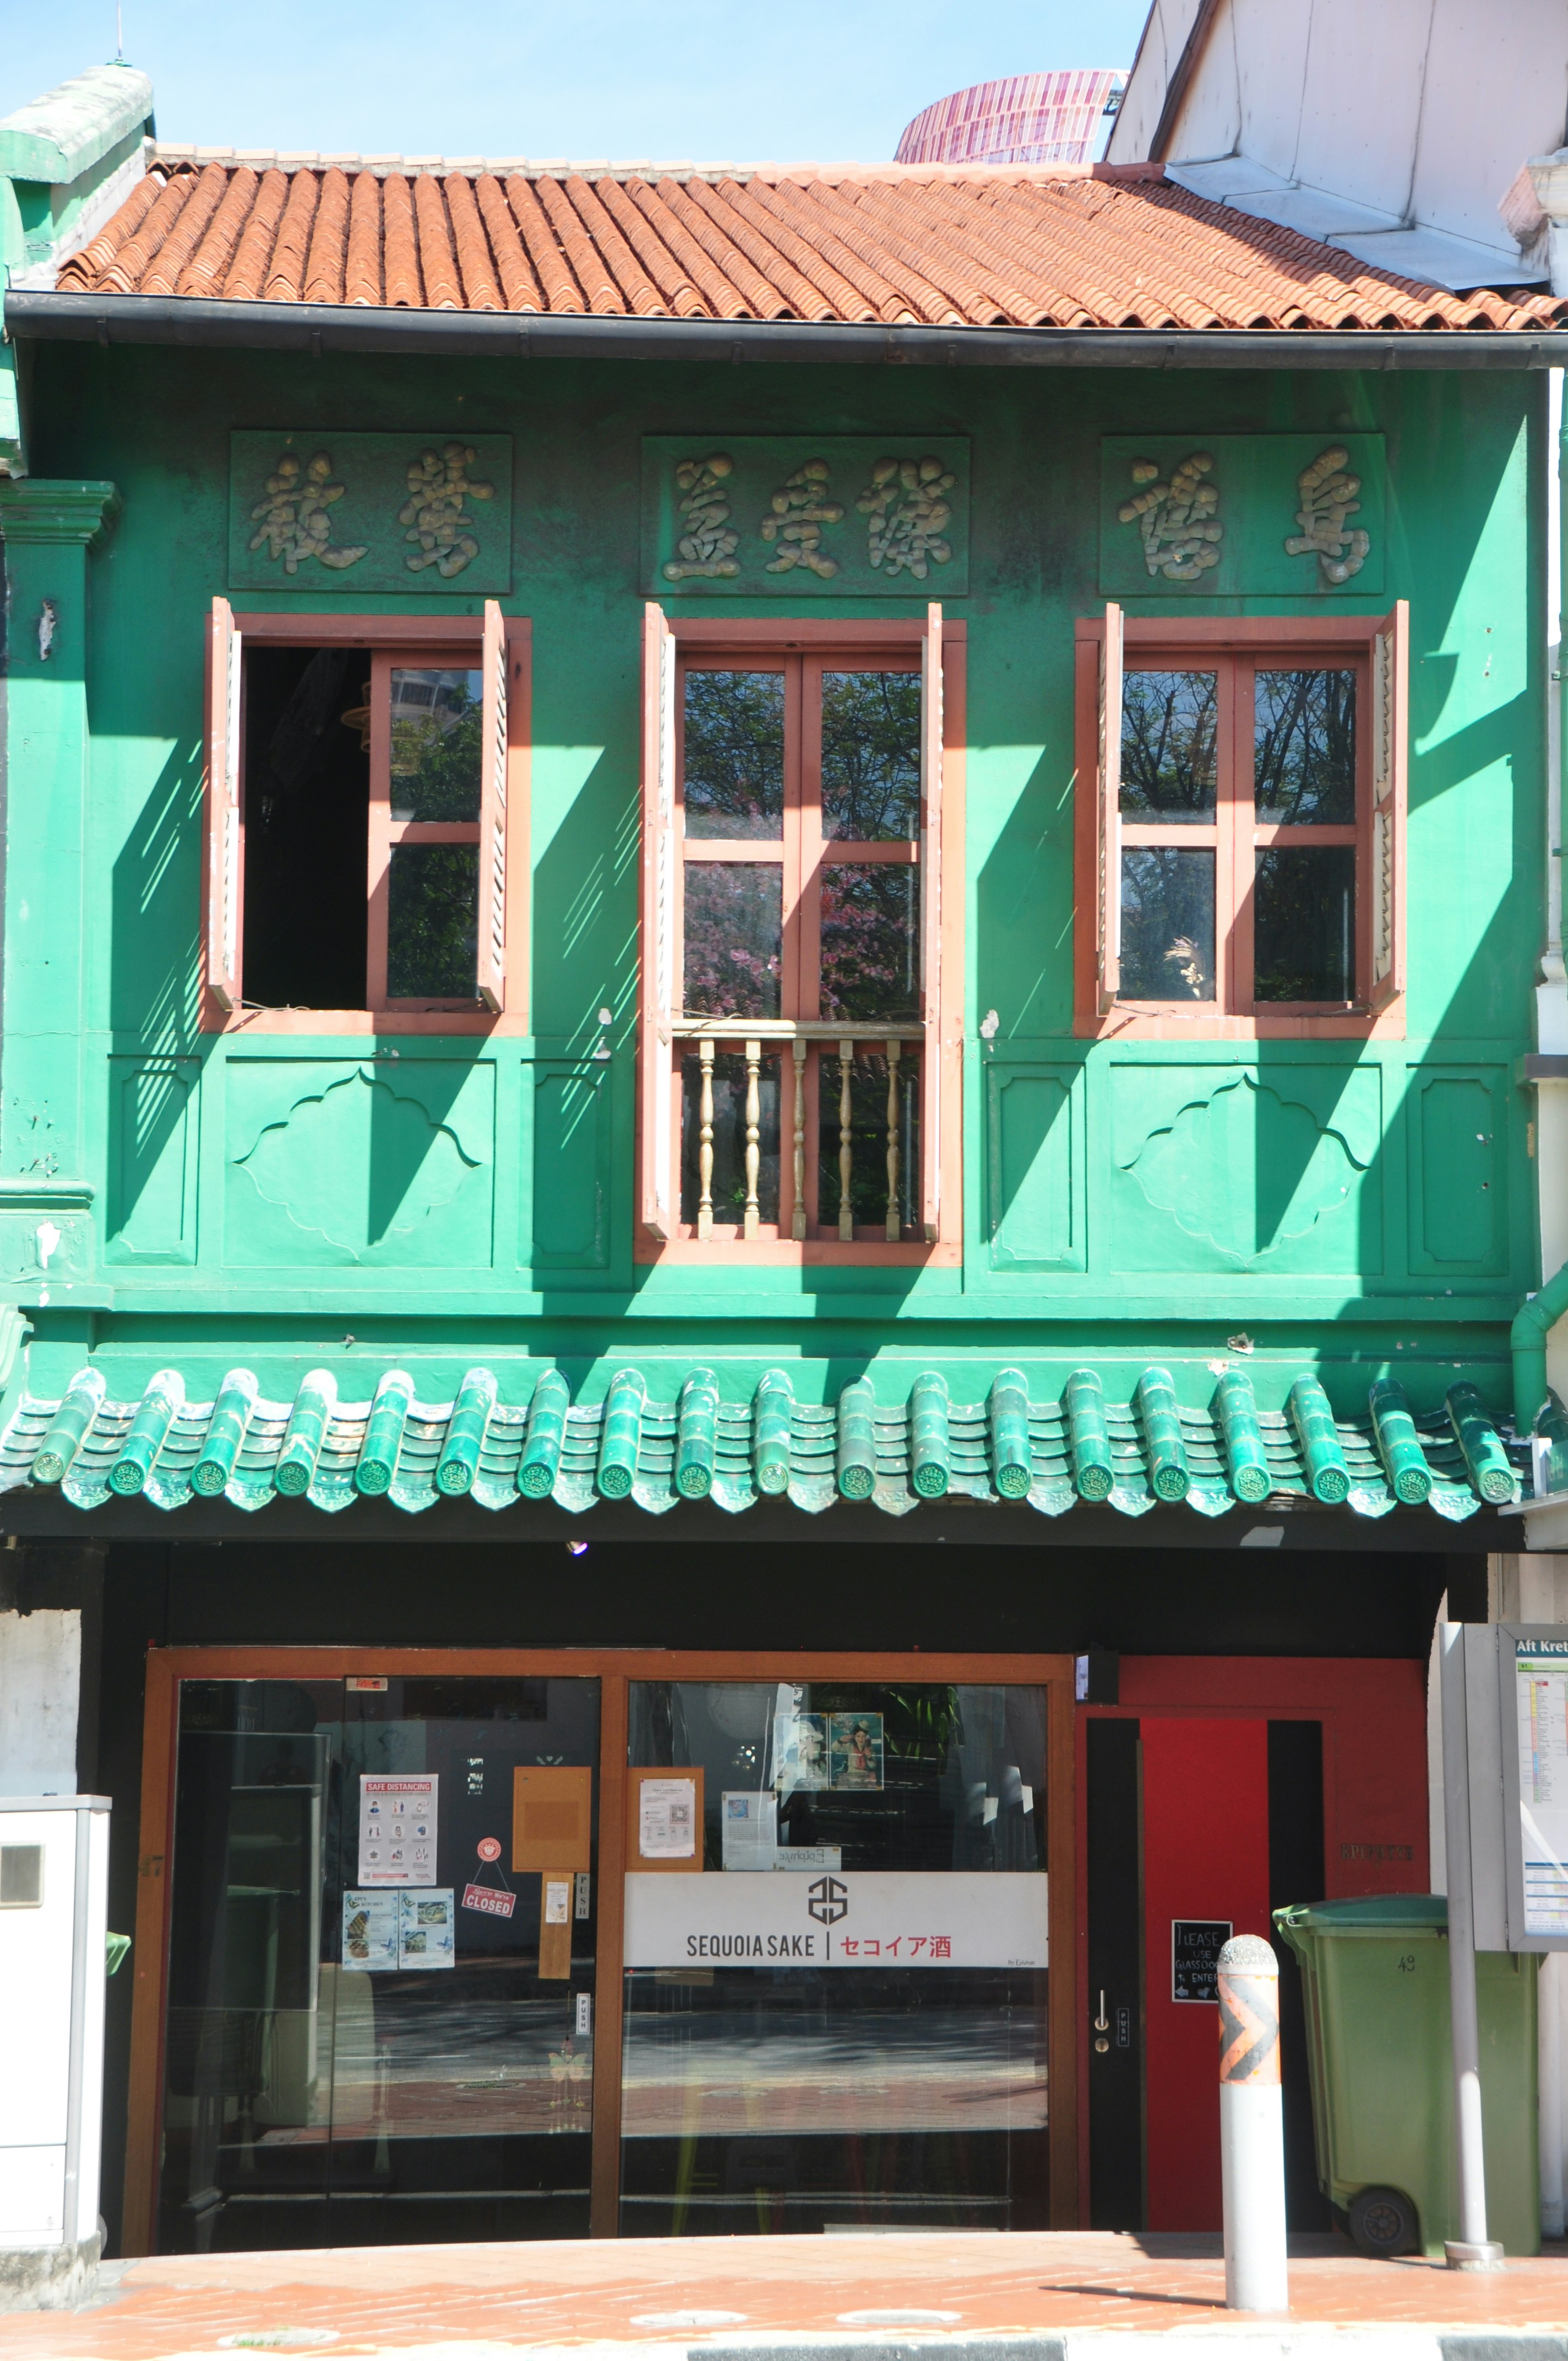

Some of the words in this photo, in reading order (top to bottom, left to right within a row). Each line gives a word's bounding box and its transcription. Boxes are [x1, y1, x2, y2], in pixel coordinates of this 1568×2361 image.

[1517, 1639, 1537, 1652] Aft
[466, 1895, 510, 1914] CLOSED
[687, 1934, 764, 1957] SEQUOIA
[767, 1935, 815, 1956] SAKE
[840, 1935, 951, 1958] セコイア酒
[1193, 1950, 1212, 1959] USE
[1175, 1960, 1200, 1970] GLASS
[1398, 1955, 1415, 1972] 49
